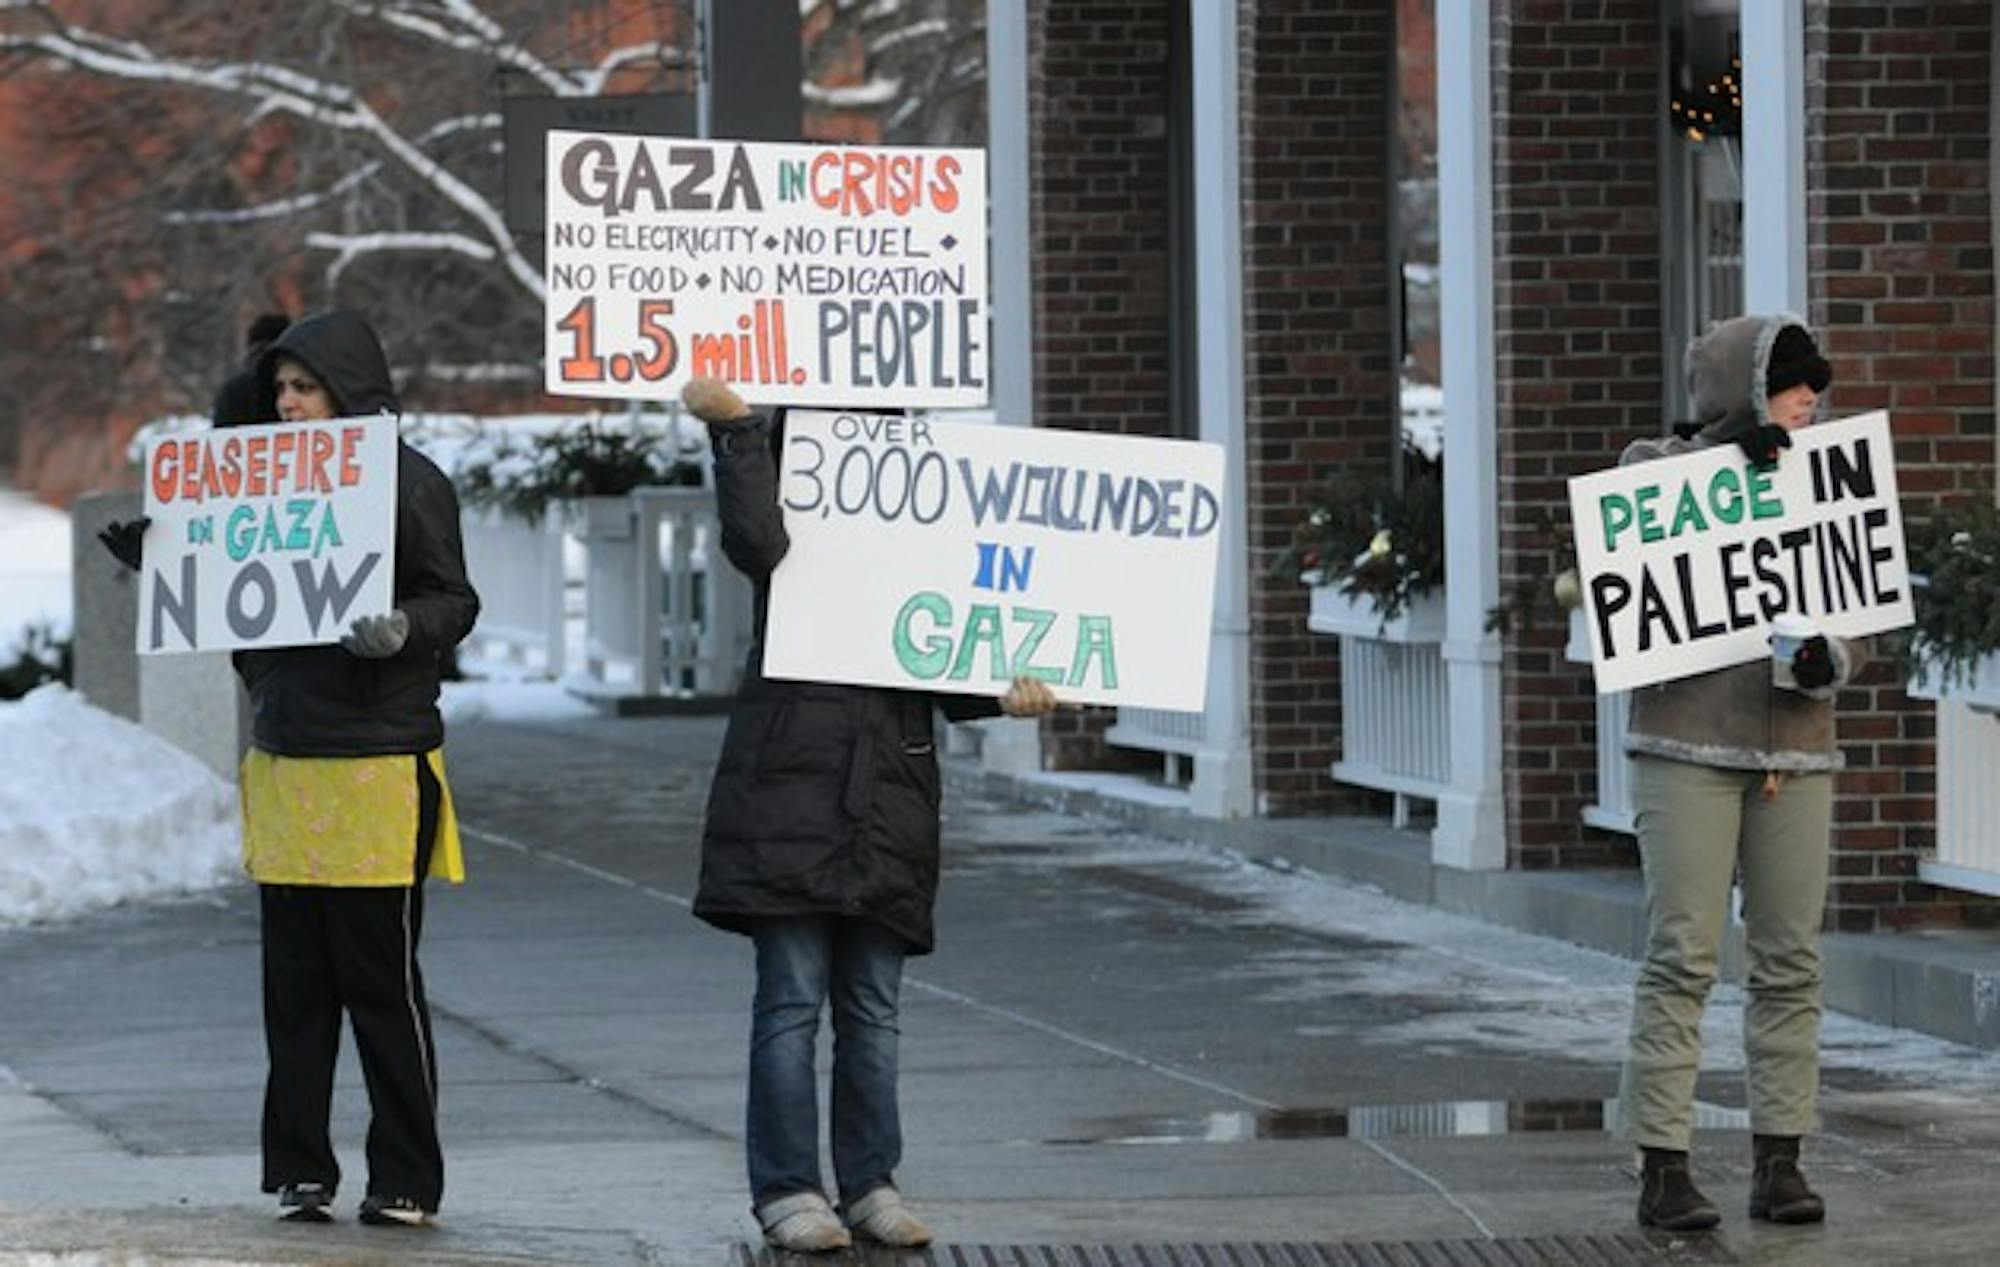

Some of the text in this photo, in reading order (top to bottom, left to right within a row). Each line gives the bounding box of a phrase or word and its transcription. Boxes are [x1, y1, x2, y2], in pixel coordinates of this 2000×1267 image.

[561, 139, 961, 216] GAZA IN CRISIS
[554, 223, 930, 257] NO ELECTRICITY NO FUEL
[553, 264, 964, 296] NO FOOD NO MEDICATION
[556, 296, 983, 388] 1.5 mill. PEOPLE
[152, 426, 366, 504] CEASEFIRE
[832, 416, 934, 446] OVER
[784, 436, 1219, 539] 3,000 WOUNDED
[1600, 439, 1876, 552] PEACE IN
[187, 499, 343, 561] IN GAZA
[973, 542, 1034, 592] IN
[151, 552, 382, 650] NOW
[1591, 508, 1899, 660] PALESTINE
[892, 591, 1118, 690] GAZA
